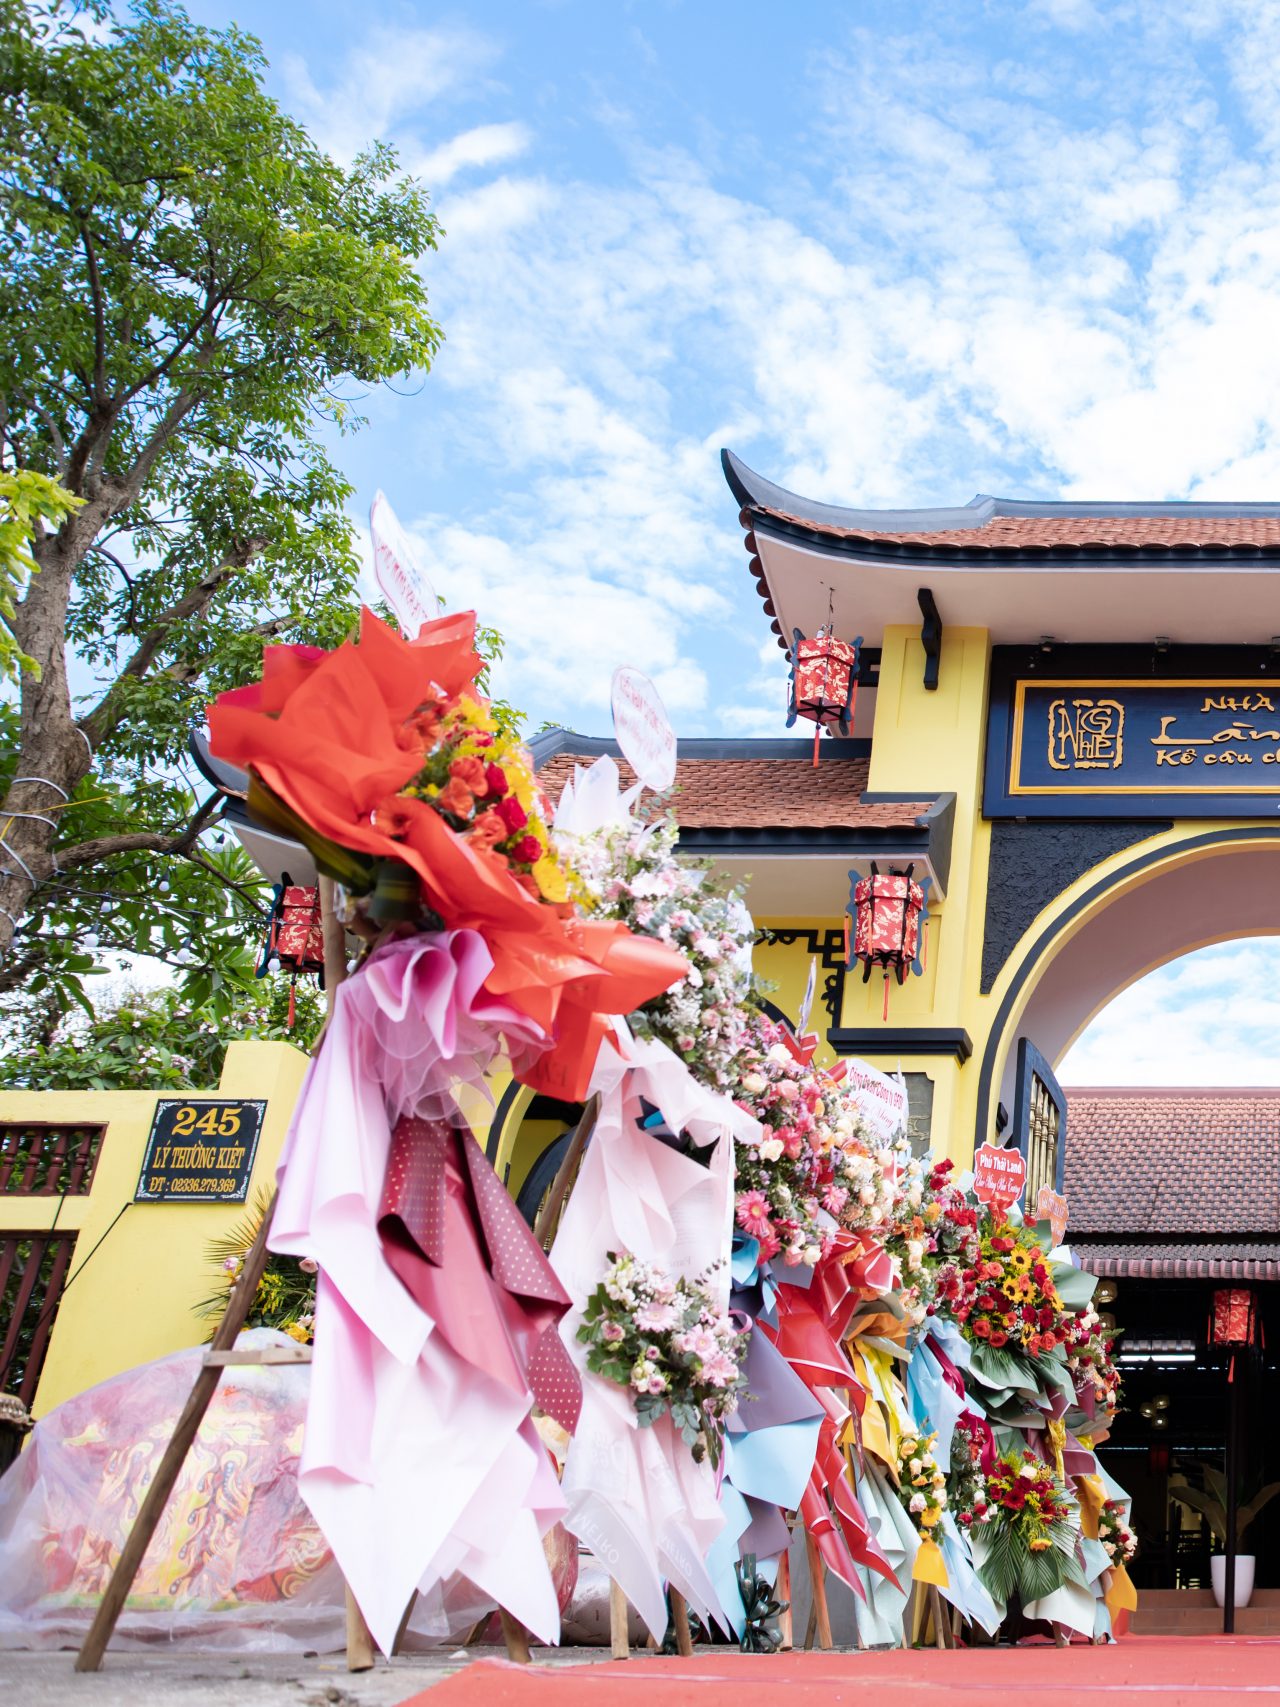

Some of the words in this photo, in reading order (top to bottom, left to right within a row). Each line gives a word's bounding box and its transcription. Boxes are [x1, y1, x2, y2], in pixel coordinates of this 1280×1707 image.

[1201, 692, 1275, 712] NHÀ
[1156, 748, 1198, 766] Kể
[1203, 750, 1253, 765] câu
[171, 1107, 243, 1136] 245
[152, 1140, 172, 1169] LÝ
[170, 1141, 217, 1169] THƯỜNG
[216, 1140, 246, 1175] KIỆT
[980, 1153, 993, 1169] Phú
[993, 1156, 1007, 1172] Thái
[1006, 1159, 1022, 1175] Land
[149, 1177, 166, 1192] ĐT
[171, 1178, 237, 1193] 02336.279.369
